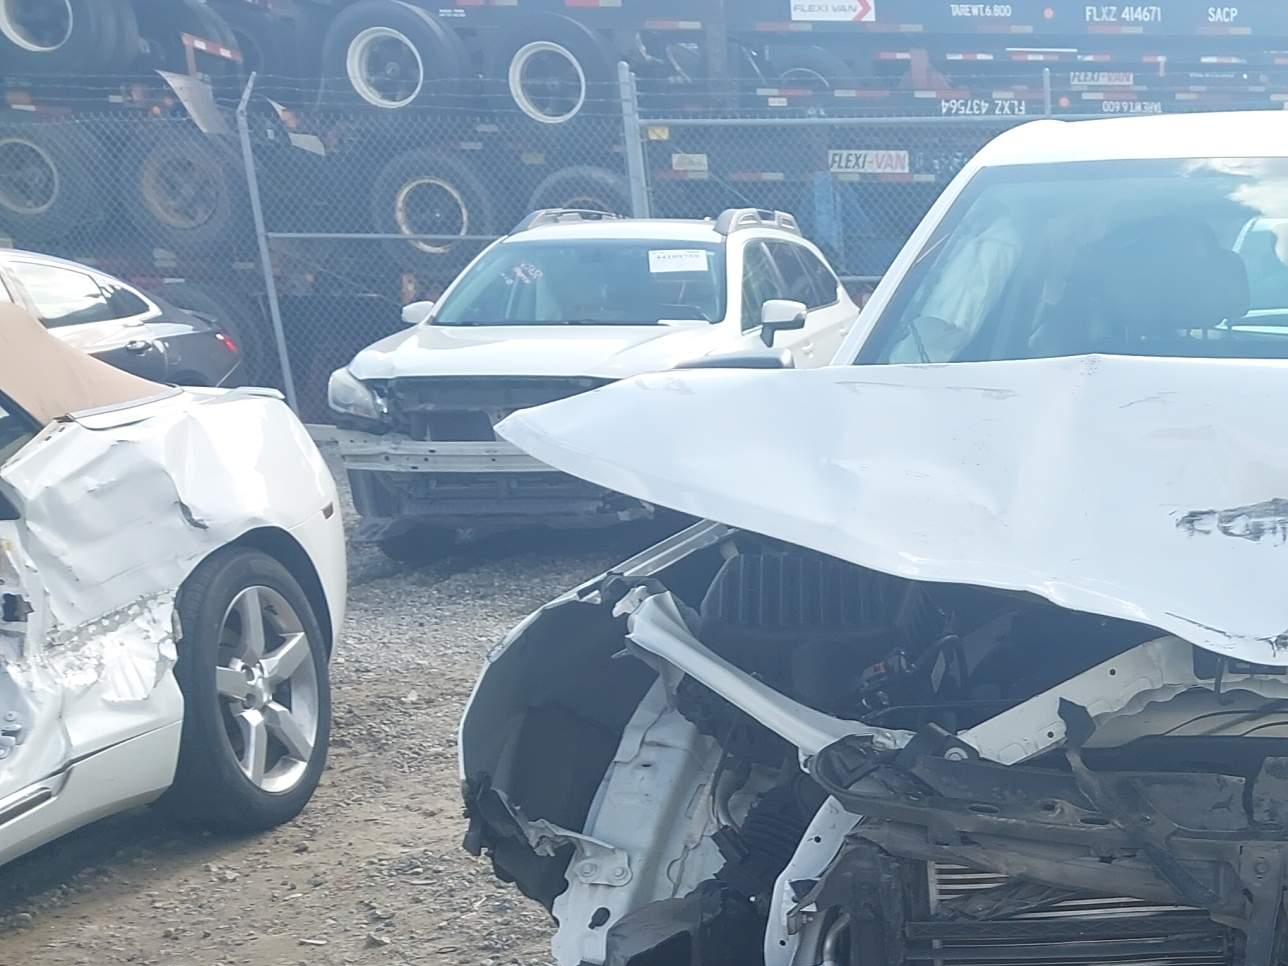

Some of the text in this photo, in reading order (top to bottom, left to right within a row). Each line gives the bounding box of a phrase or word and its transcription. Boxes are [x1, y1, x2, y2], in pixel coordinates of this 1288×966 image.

[1085, 6, 1162, 22] FLXZ 414671
[1207, 7, 1238, 22] SACP
[941, 99, 1026, 115] FLXZ 437564
[830, 152, 906, 170] FLEXI-VAN
